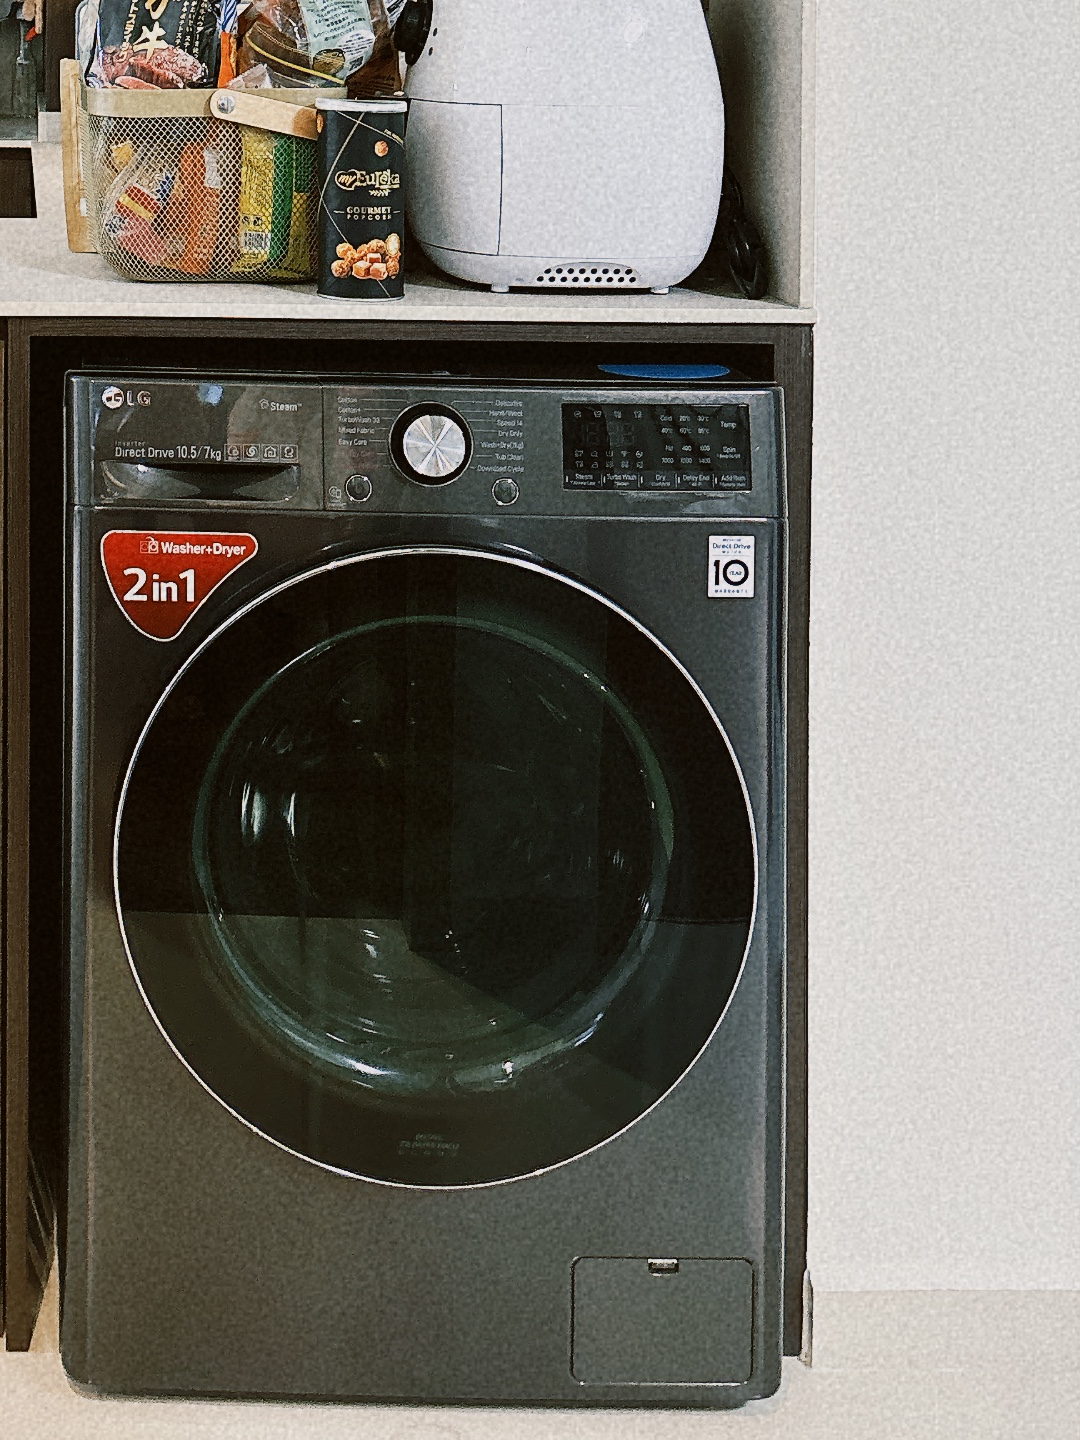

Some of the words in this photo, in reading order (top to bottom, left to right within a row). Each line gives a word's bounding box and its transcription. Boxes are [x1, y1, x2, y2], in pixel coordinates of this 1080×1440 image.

[347, 206, 392, 214] GOURMET
[126, 390, 152, 407] LG
[115, 446, 146, 458] Direct
[148, 447, 175, 458] Drive
[161, 542, 246, 558] Washer+Dryer
[713, 559, 749, 586] 10
